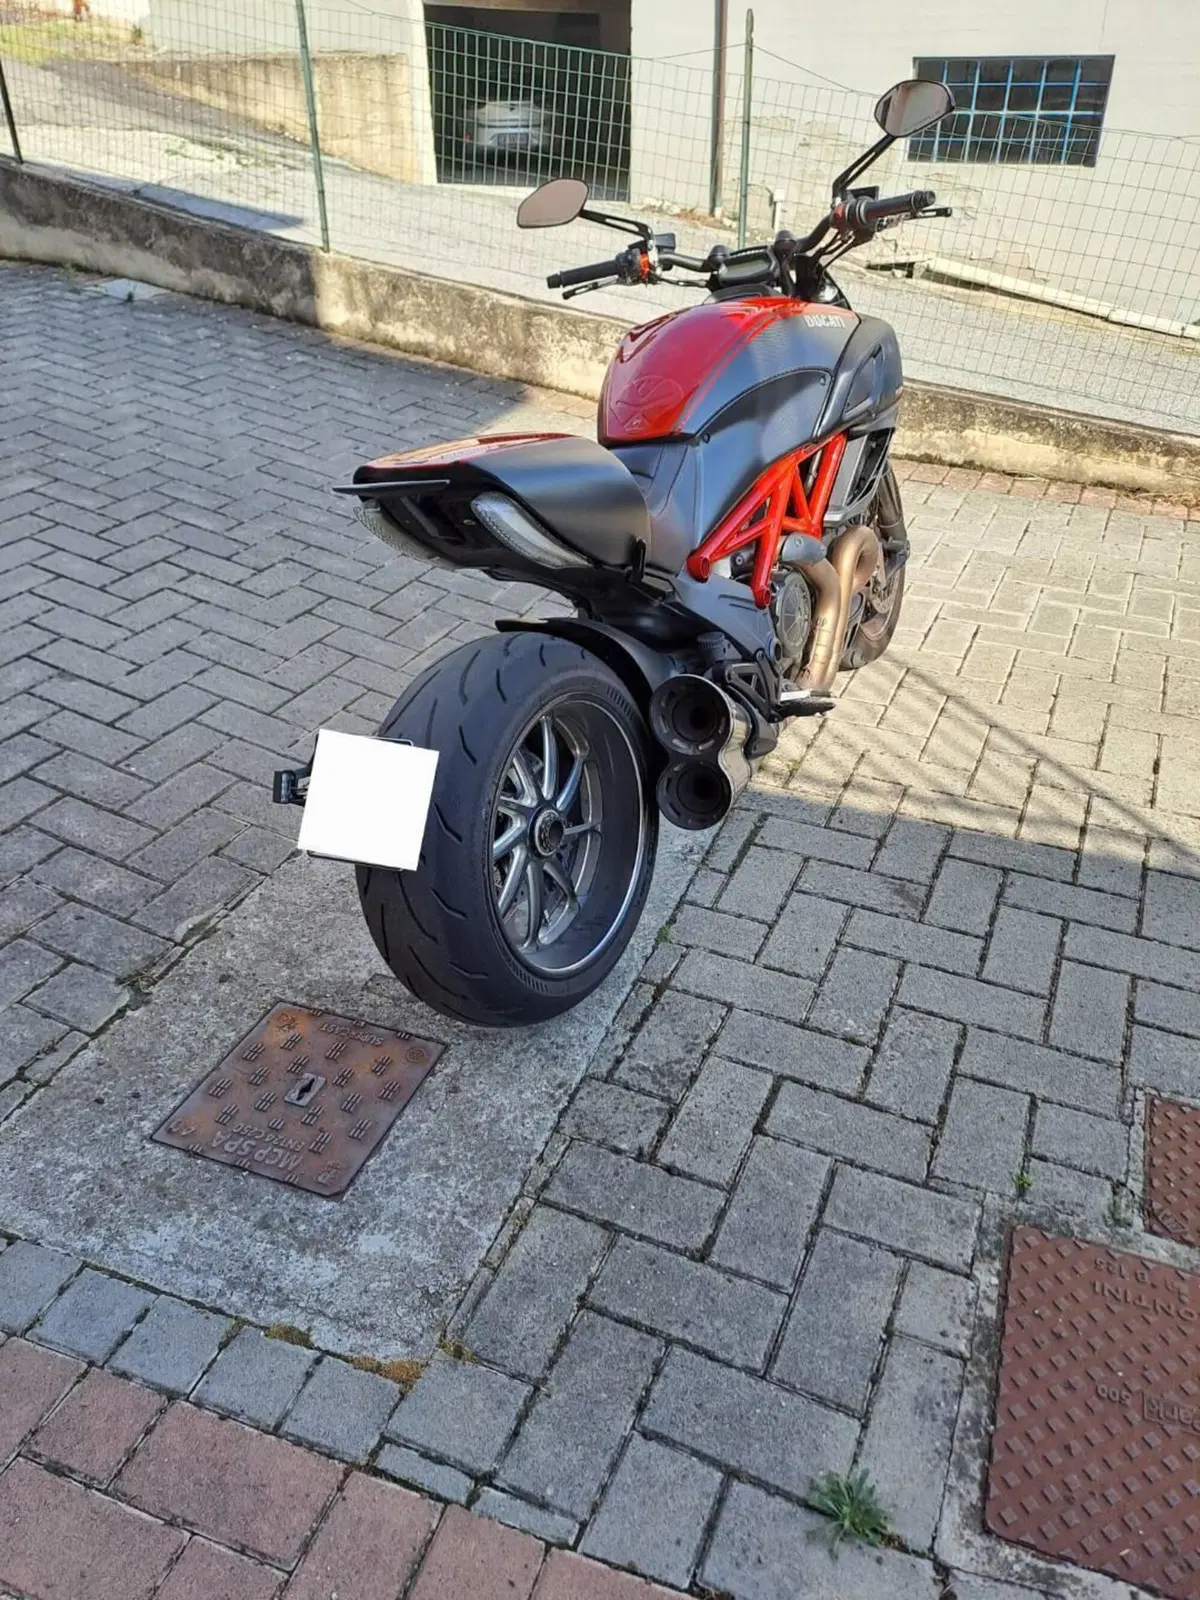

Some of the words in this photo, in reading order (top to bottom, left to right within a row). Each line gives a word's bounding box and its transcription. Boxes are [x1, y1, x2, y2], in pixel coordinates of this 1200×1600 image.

[803, 314, 846, 328] DUCATI
[319, 1022, 384, 1046] SUPERCAST
[253, 1146, 303, 1171] MCP
[1090, 1280, 1200, 1323] ONTINI
